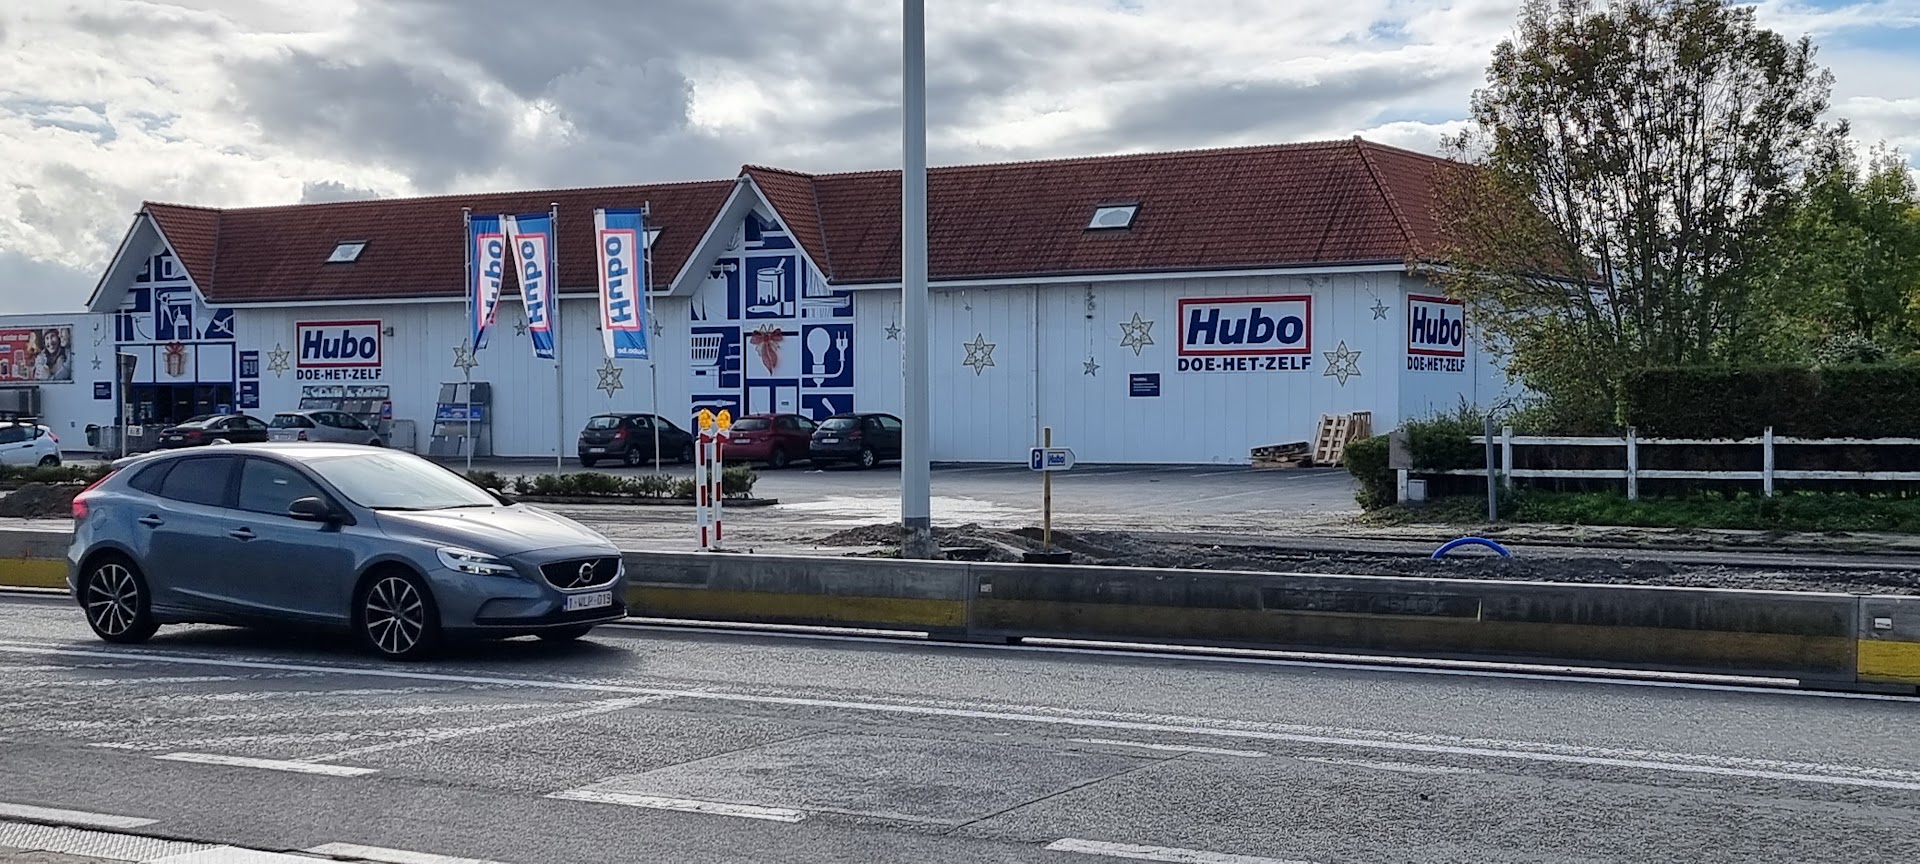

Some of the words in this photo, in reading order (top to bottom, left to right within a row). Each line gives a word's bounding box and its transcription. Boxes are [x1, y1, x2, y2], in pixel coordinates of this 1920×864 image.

[1187, 307, 1304, 345] Hubo
[1411, 306, 1462, 347] Hubo
[302, 329, 376, 359] Hubo
[1177, 356, 1312, 372] DOE-HET-ZELF
[1407, 356, 1466, 372] DOE-HET-ZELF
[296, 368, 382, 380] DOE-HET-ZELF
[1034, 451, 1041, 468] P
